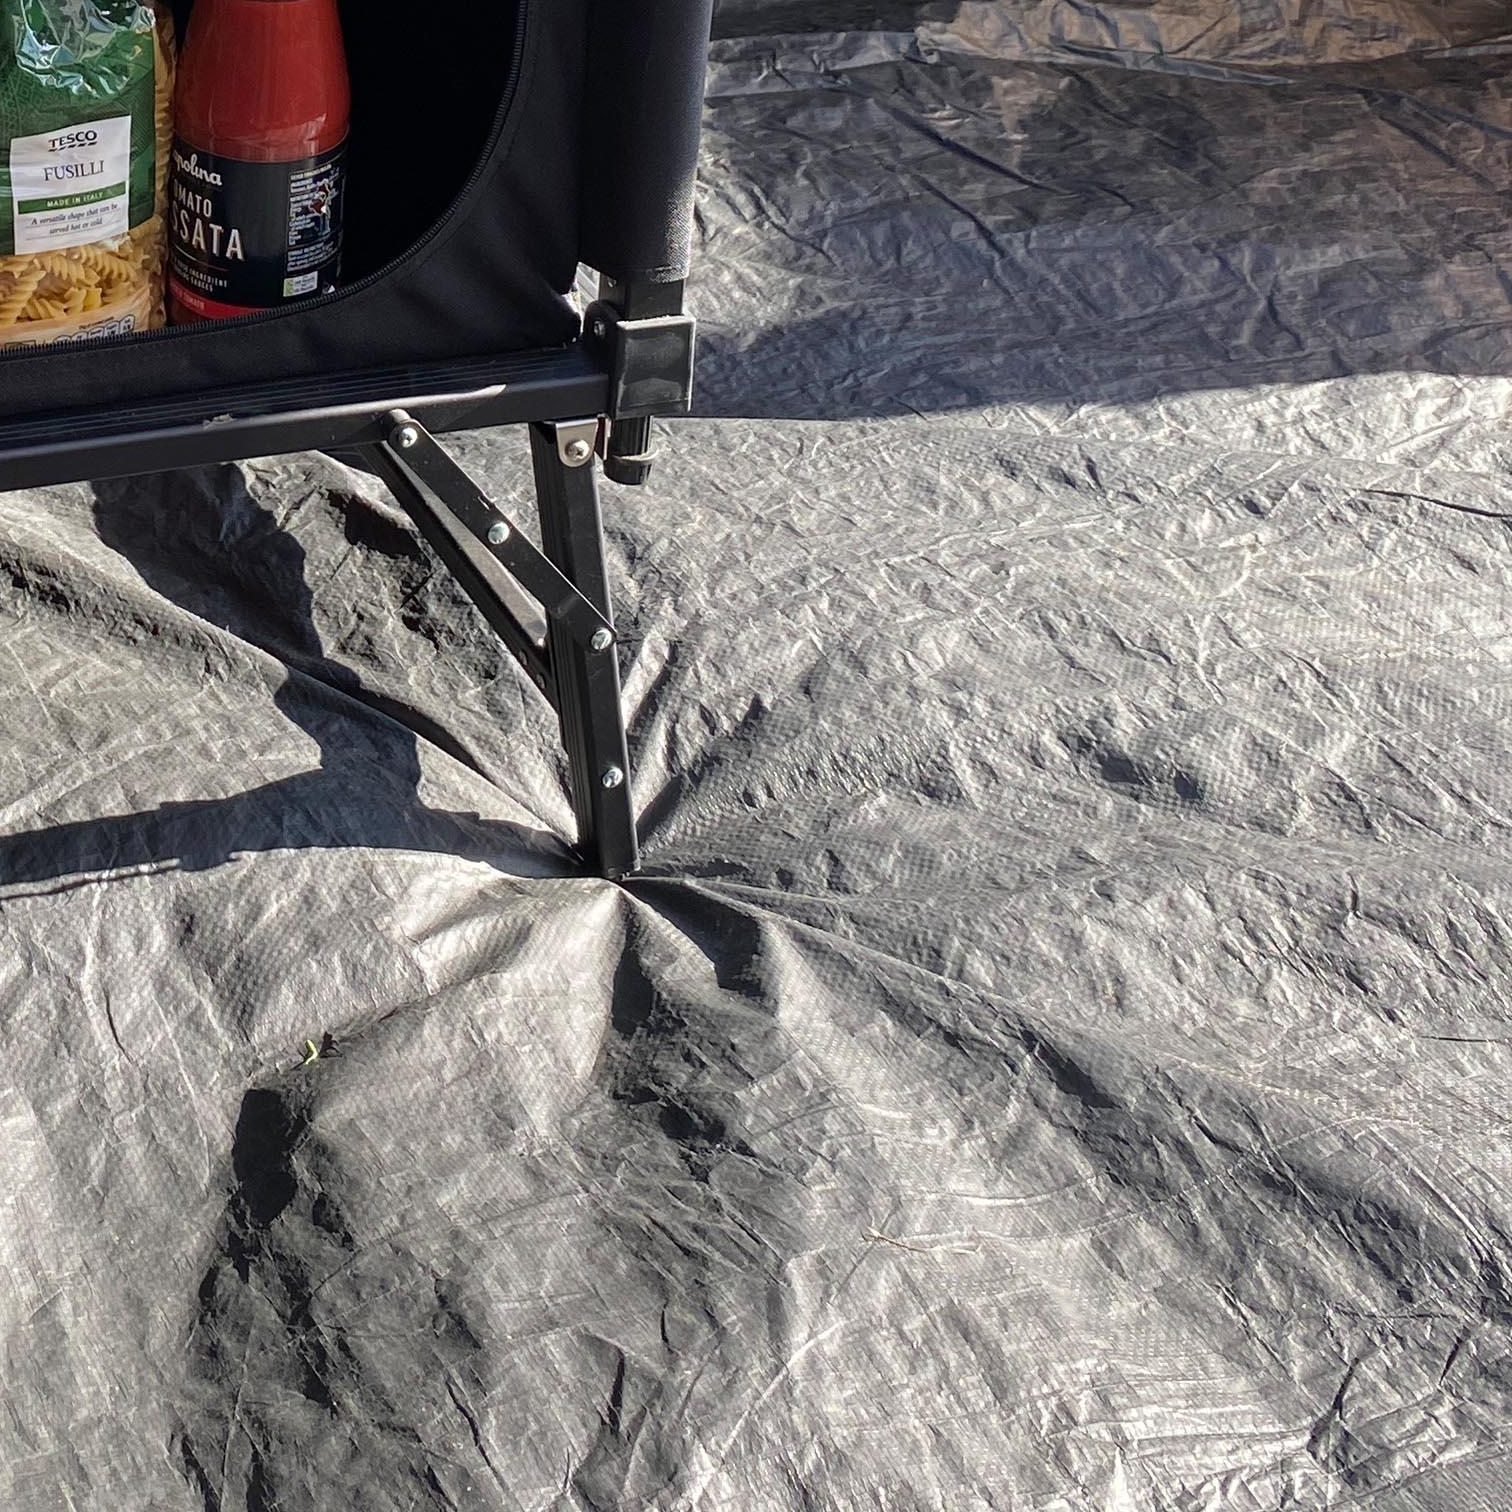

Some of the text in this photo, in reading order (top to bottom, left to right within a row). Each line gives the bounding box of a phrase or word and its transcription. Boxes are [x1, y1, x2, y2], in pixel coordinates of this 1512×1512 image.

[48, 130, 98, 149] TESCO
[44, 160, 105, 181] FUSILLI
[47, 192, 104, 207] MADE IN ITALY
[172, 199, 245, 262] SSATA
